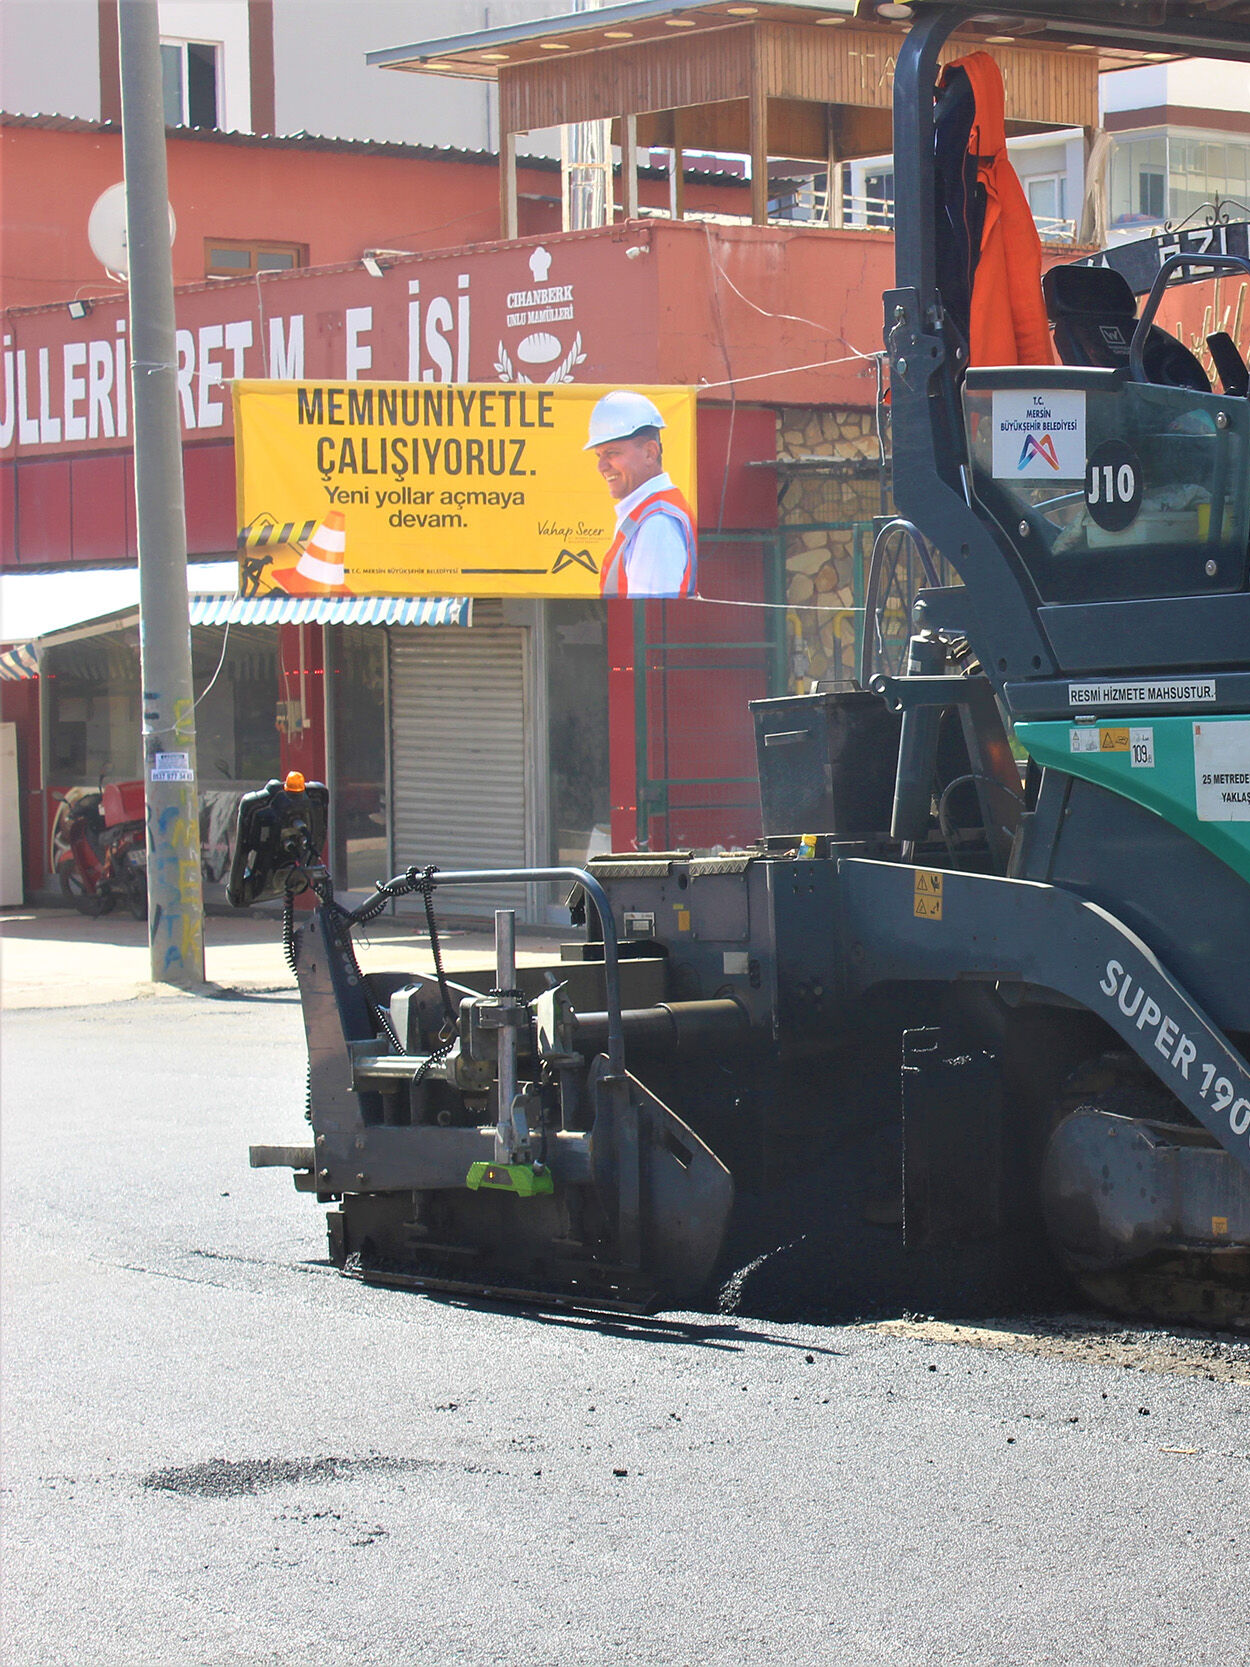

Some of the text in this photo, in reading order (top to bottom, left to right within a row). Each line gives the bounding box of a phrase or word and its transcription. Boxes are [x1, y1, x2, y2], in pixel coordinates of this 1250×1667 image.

[297, 385, 555, 428] MEMNUNİYETLE
[1033, 396, 1044, 406] T.C.
[1026, 407, 1051, 418] MERSİN
[1001, 420, 1077, 433] BÜYÜKŞEHİR BELEDİYESİ
[317, 436, 537, 482] ÇALIŞIYORUZ.
[1088, 464, 1135, 504] J10
[324, 486, 525, 510] Yeni yollar açmaya
[389, 510, 468, 528] devam.
[537, 520, 574, 542] Vahap
[1071, 685, 1214, 702] RESMİ HİZMETE MAHSUSTUR.
[1202, 774, 1212, 784] 25
[1099, 959, 1197, 1081] SUPER
